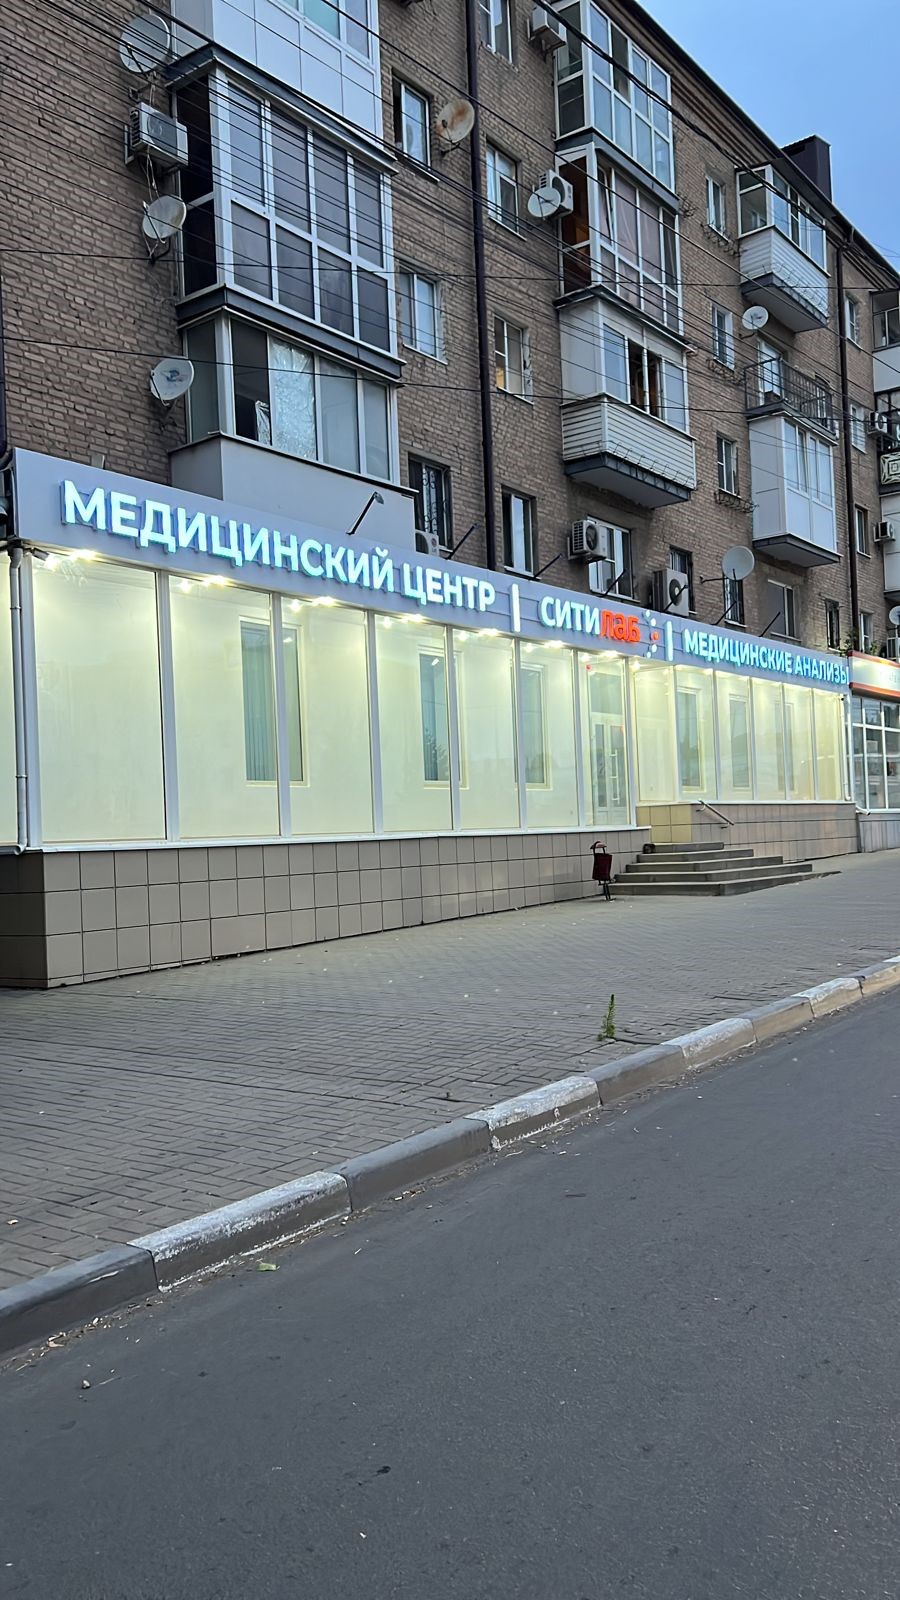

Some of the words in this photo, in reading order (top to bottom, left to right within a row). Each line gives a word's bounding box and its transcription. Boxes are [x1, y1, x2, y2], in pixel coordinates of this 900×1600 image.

[62, 479, 394, 592] МЕДИЦИНСКИЙ
[401, 563, 495, 611] ЦЕНТР
[683, 629, 792, 673] МЕДИЦИНСКИЕ
[795, 655, 849, 684] АНАЛИЗЫ
